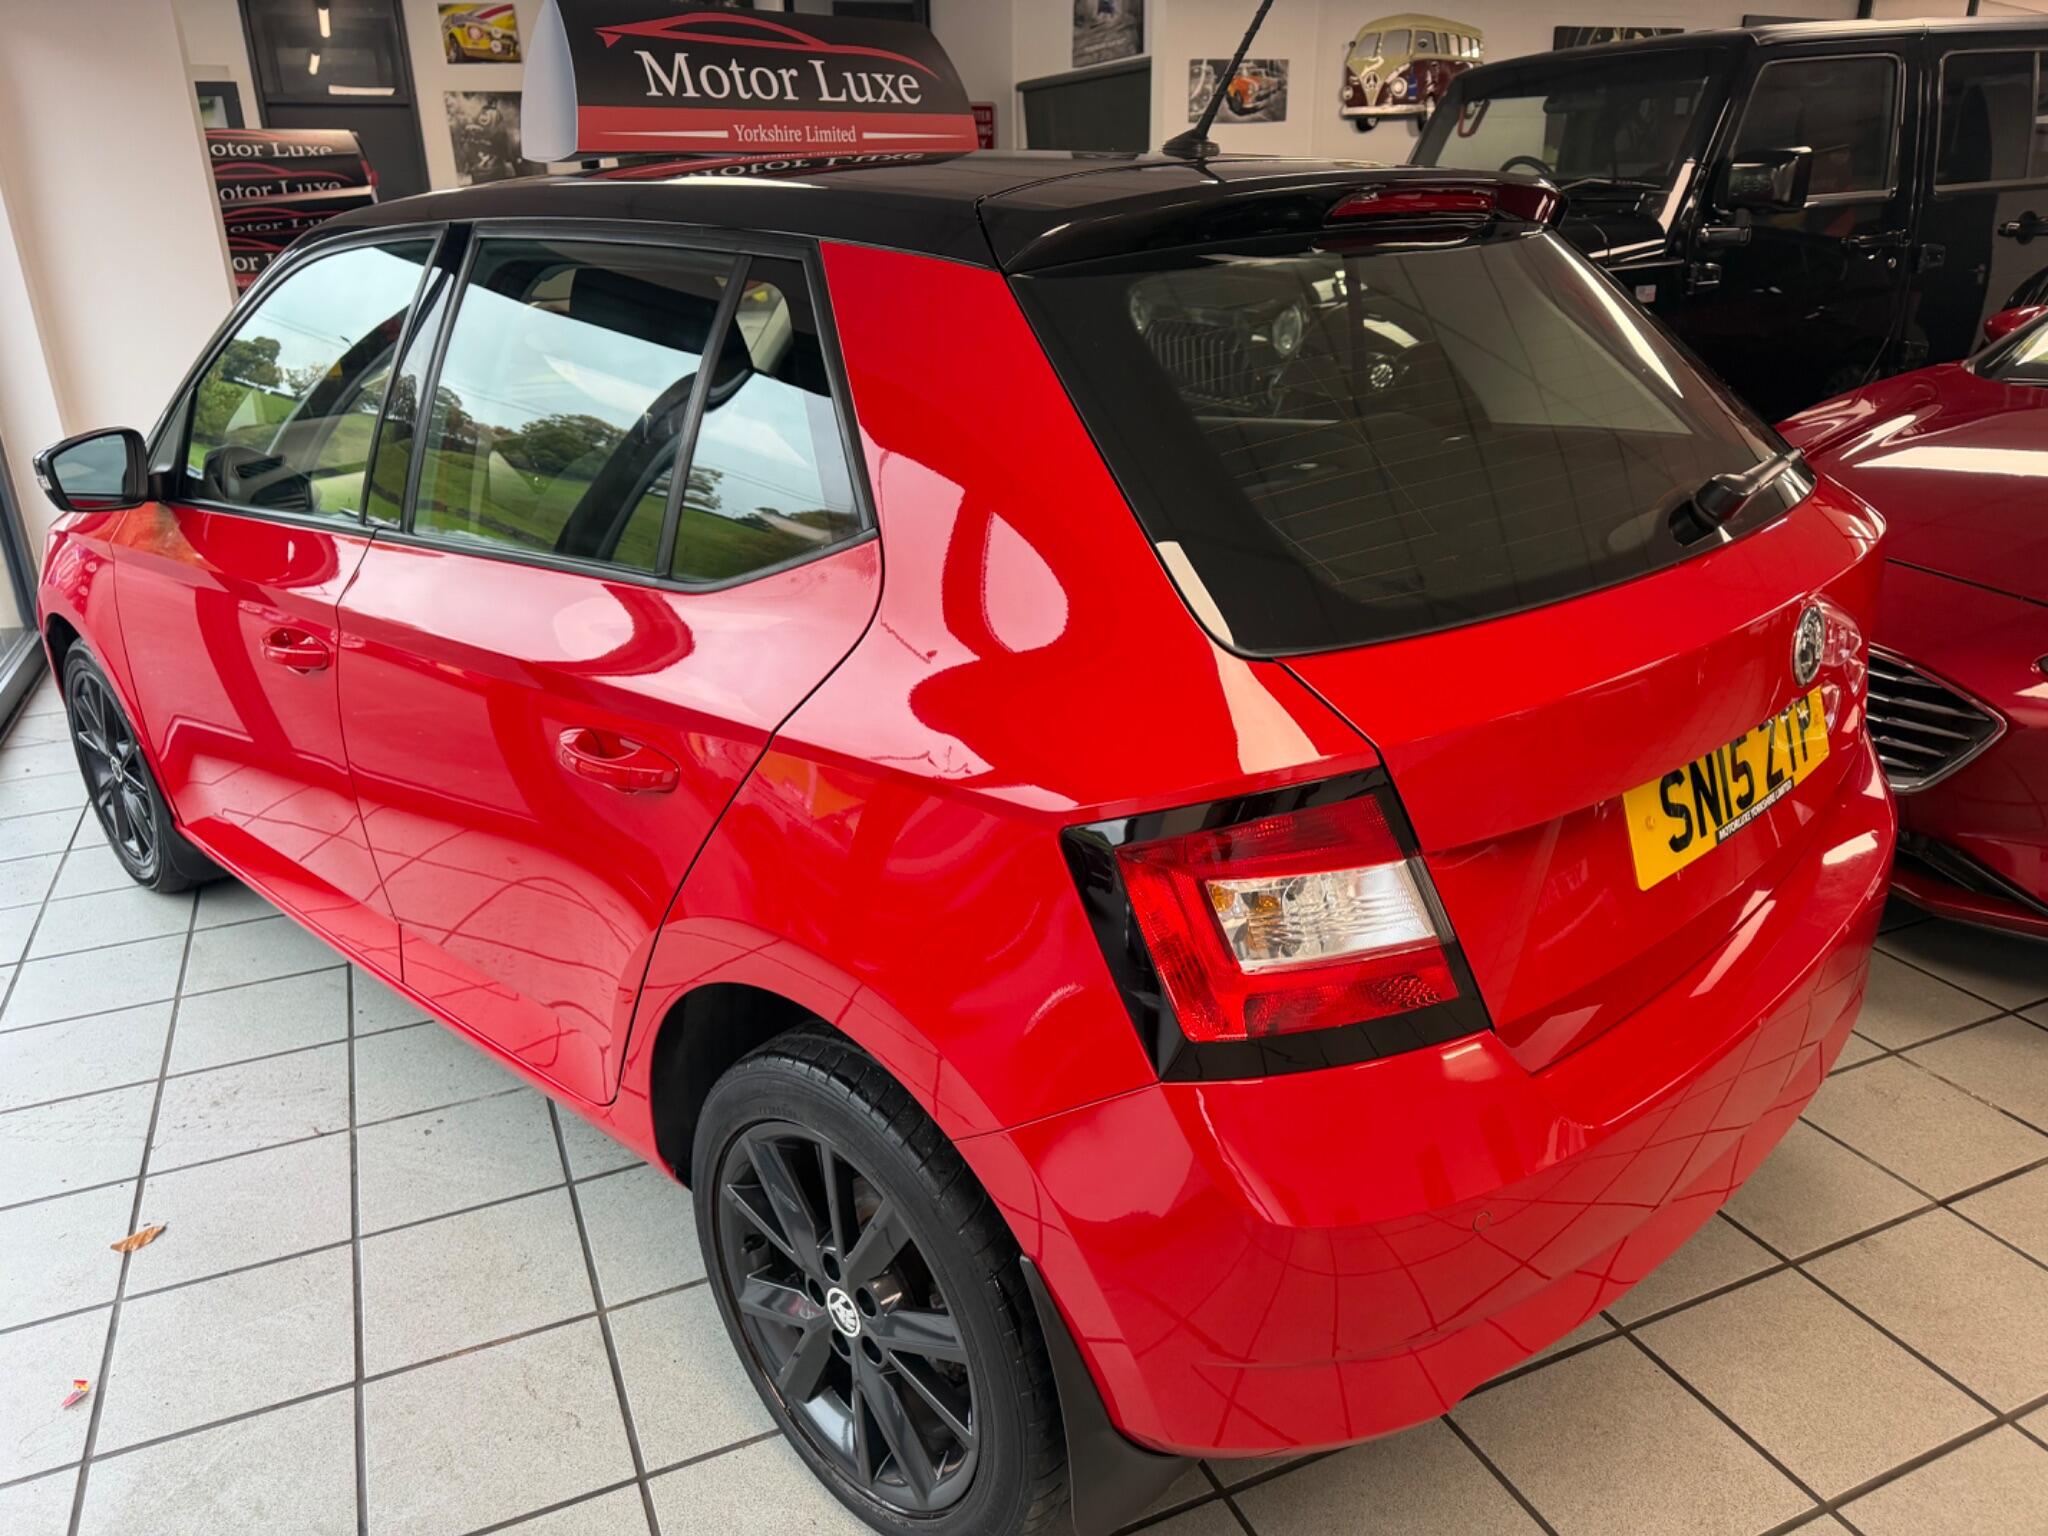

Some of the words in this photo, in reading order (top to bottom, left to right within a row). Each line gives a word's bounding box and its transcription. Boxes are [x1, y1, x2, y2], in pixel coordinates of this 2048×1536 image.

[634, 49, 799, 101] Motor
[808, 59, 922, 105] Luxe
[733, 123, 802, 143] Yorkshire
[804, 124, 858, 143] Limited
[210, 141, 263, 157] otor
[219, 183, 272, 201] otor
[1658, 734, 1755, 853] SN15
